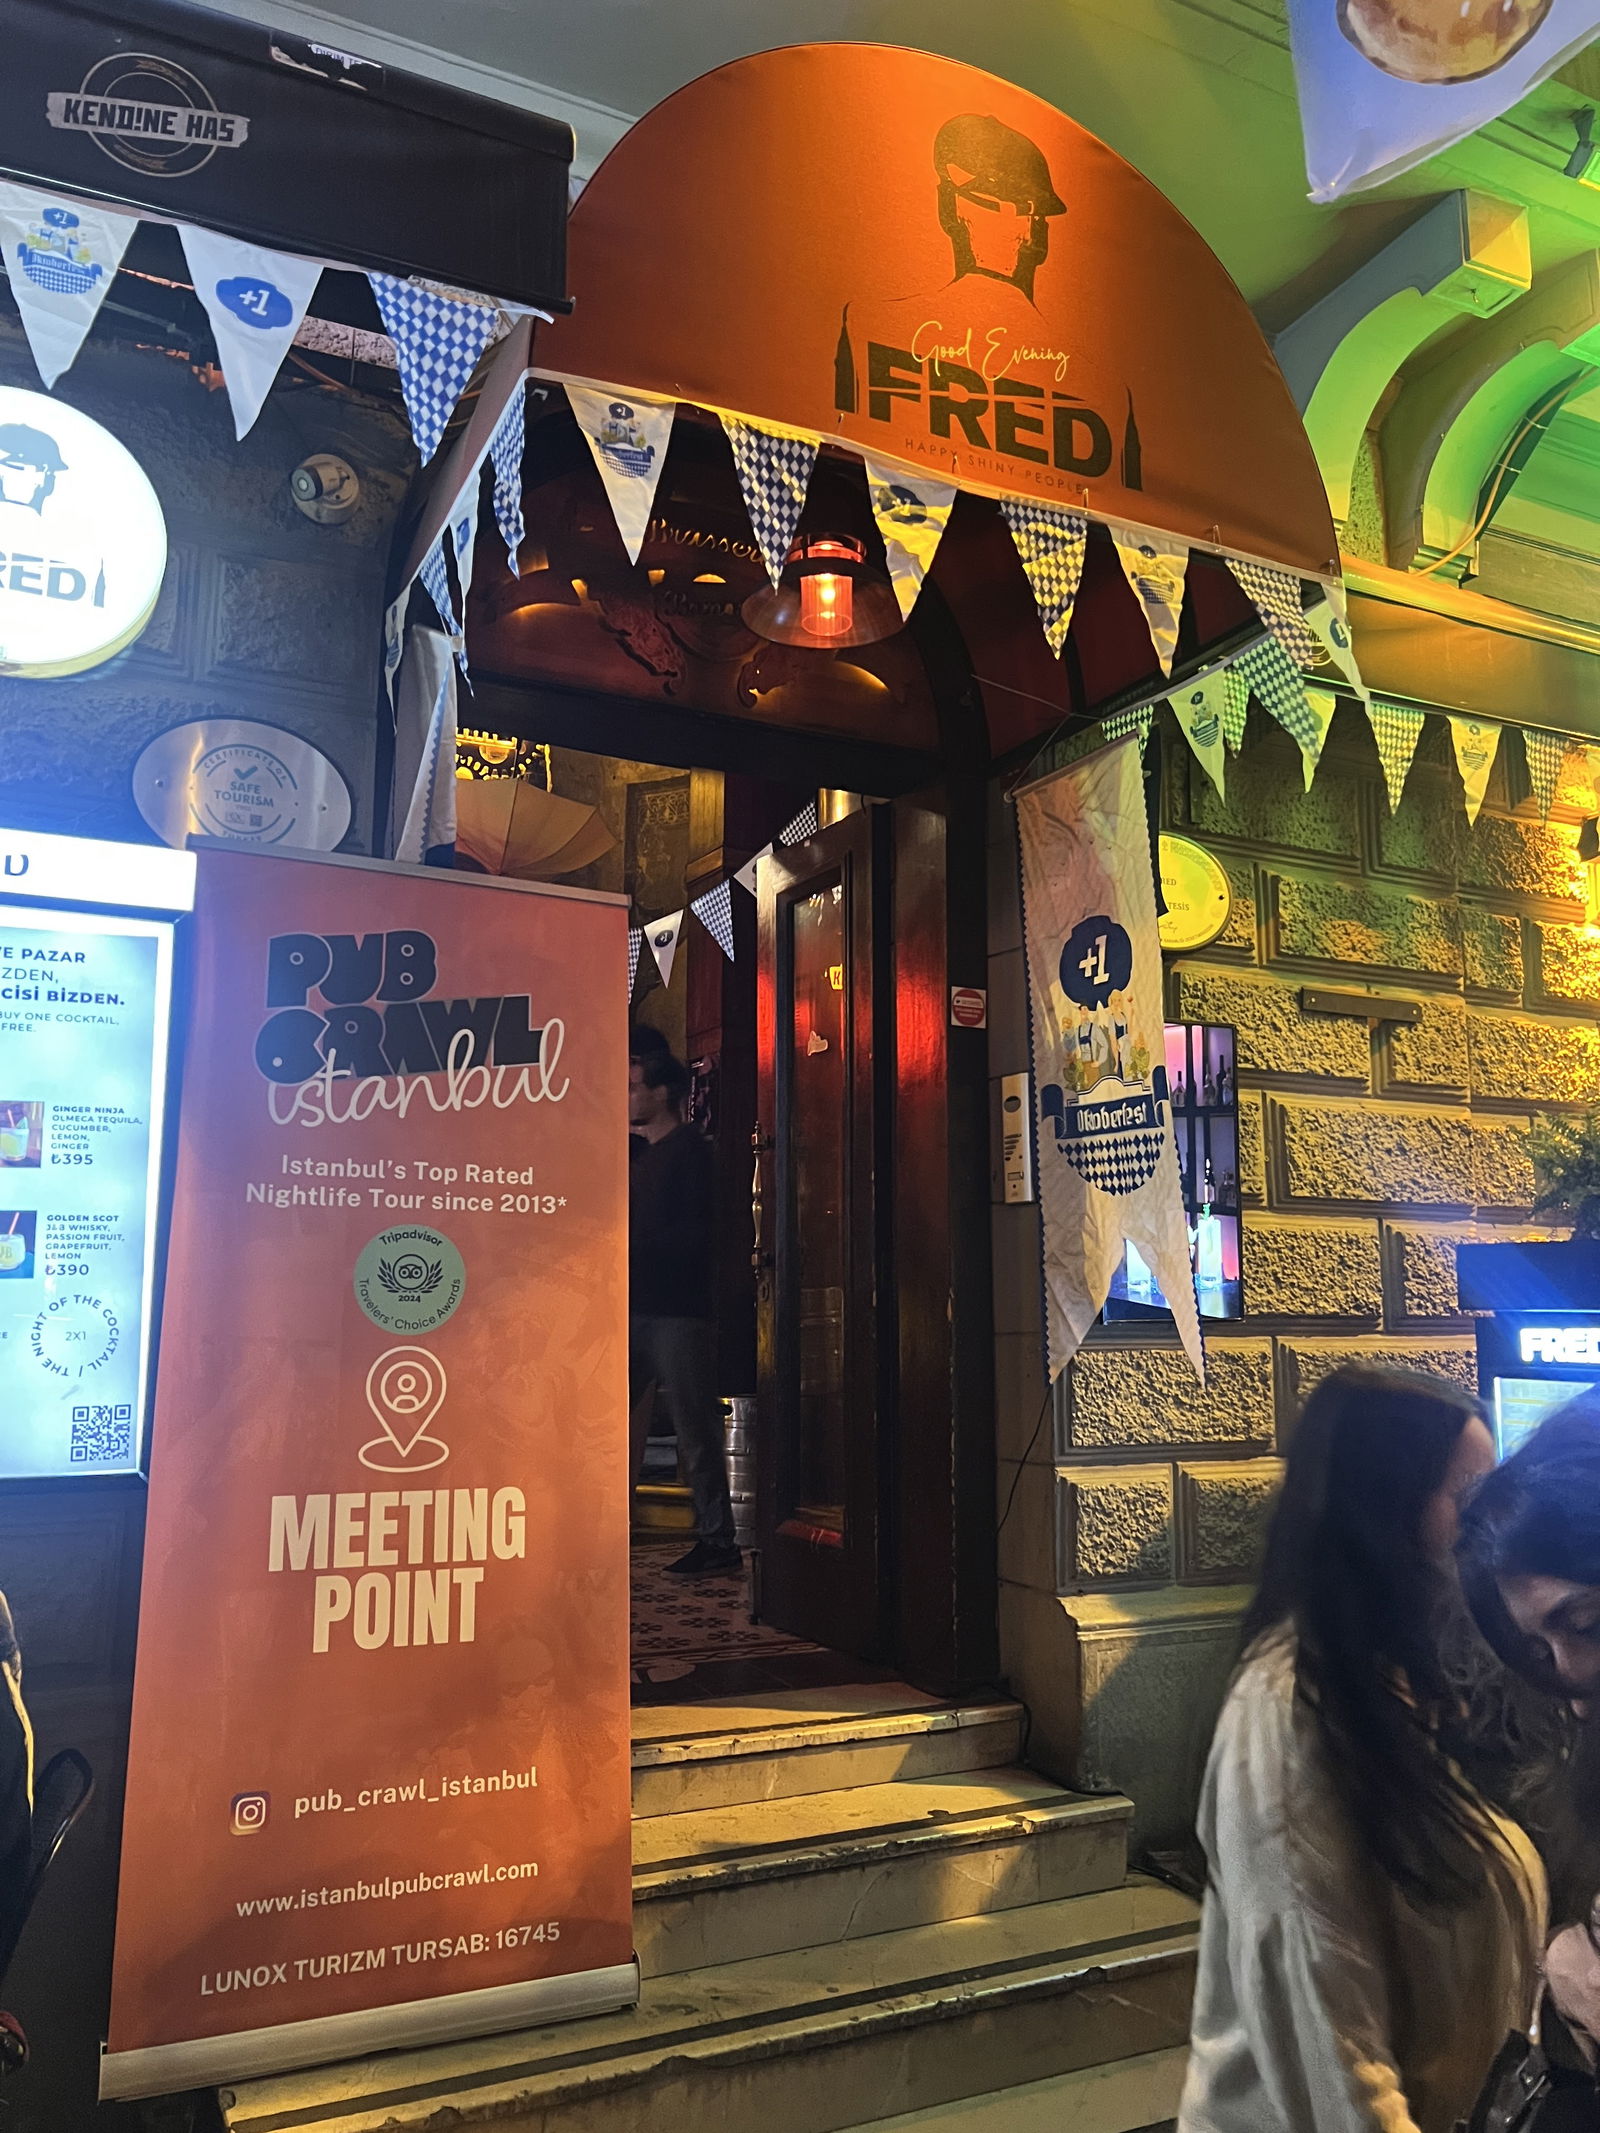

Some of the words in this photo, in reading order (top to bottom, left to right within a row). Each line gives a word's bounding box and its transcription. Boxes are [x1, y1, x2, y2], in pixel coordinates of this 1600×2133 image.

[186, 114, 235, 142] HAS
[53, 212, 68, 225] +1
[239, 289, 270, 317] +1
[911, 320, 973, 377] Good
[982, 327, 1070, 382] Evening
[867, 341, 1112, 478] FRED
[904, 437, 958, 459] HAPPY
[968, 454, 1015, 474] SHINY
[1025, 470, 1084, 495] PEOPLE
[0, 552, 87, 602] ED
[204, 749, 274, 769] CERTIFICATE
[230, 781, 261, 795] SAFE
[214, 790, 274, 808] TOURISM
[22, 948, 86, 963] PAZAR
[1079, 934, 1110, 986] +1
[2, 967, 59, 984] ZDEN,
[265, 928, 438, 1010] PUB
[47, 987, 125, 1006] BİZDEN.
[25, 1012, 51, 1022] ONE
[56, 1014, 119, 1026] COCKTAIL,
[254, 993, 544, 1087] CRAWL
[268, 1017, 570, 1128] istanbul
[52, 1114, 94, 1122] OLMECA
[98, 1116, 143, 1125] TEQUILA,
[53, 1105, 91, 1113] GINGER
[95, 1106, 125, 1115] NINJA
[1077, 1102, 1148, 1133] Oktoberfest
[51, 1124, 112, 1133] CUCUMBER,
[51, 1133, 90, 1142] LEMON,
[51, 1142, 89, 1150] GINGER
[51, 1153, 94, 1165] ₺395
[281, 1153, 407, 1180] Istanbul's
[414, 1161, 458, 1185] Top
[465, 1164, 534, 1186] Rated
[246, 1182, 361, 1209] Nightlife
[369, 1188, 425, 1209] Tour
[431, 1191, 494, 1212] since
[46, 1233, 90, 1241] PASSION
[94, 1234, 125, 1242] FRUIT,
[69, 1224, 111, 1232] WHISKY,
[45, 1243, 112, 1251] GRAPEFRUIT,
[379, 1229, 443, 1247] Tripadvisor
[45, 1252, 81, 1260] LEMON
[45, 1264, 89, 1276] ₺390
[49, 1296, 68, 1311] OF
[73, 1294, 102, 1309] THE
[359, 1278, 394, 1324] Travelers'
[394, 1316, 437, 1330] Choice
[436, 1278, 461, 1319] Awards
[398, 1295, 421, 1303] 2024
[31, 1312, 48, 1357] NIGHT
[65, 1331, 87, 1341] 2X1
[87, 1309, 120, 1370] COCKTAIL
[41, 1358, 69, 1377] THE
[268, 1486, 526, 1572] MEETING
[312, 1567, 484, 1654] POINT
[294, 1766, 539, 1819] pub_crawl_istanbul
[236, 1862, 539, 1918] www.istanbulpubcrawl.com
[200, 1962, 288, 1996] LUNOX
[294, 1948, 386, 1981] TURIZM
[392, 1933, 490, 1966] TURSAB:
[496, 1921, 561, 1950] 16745
